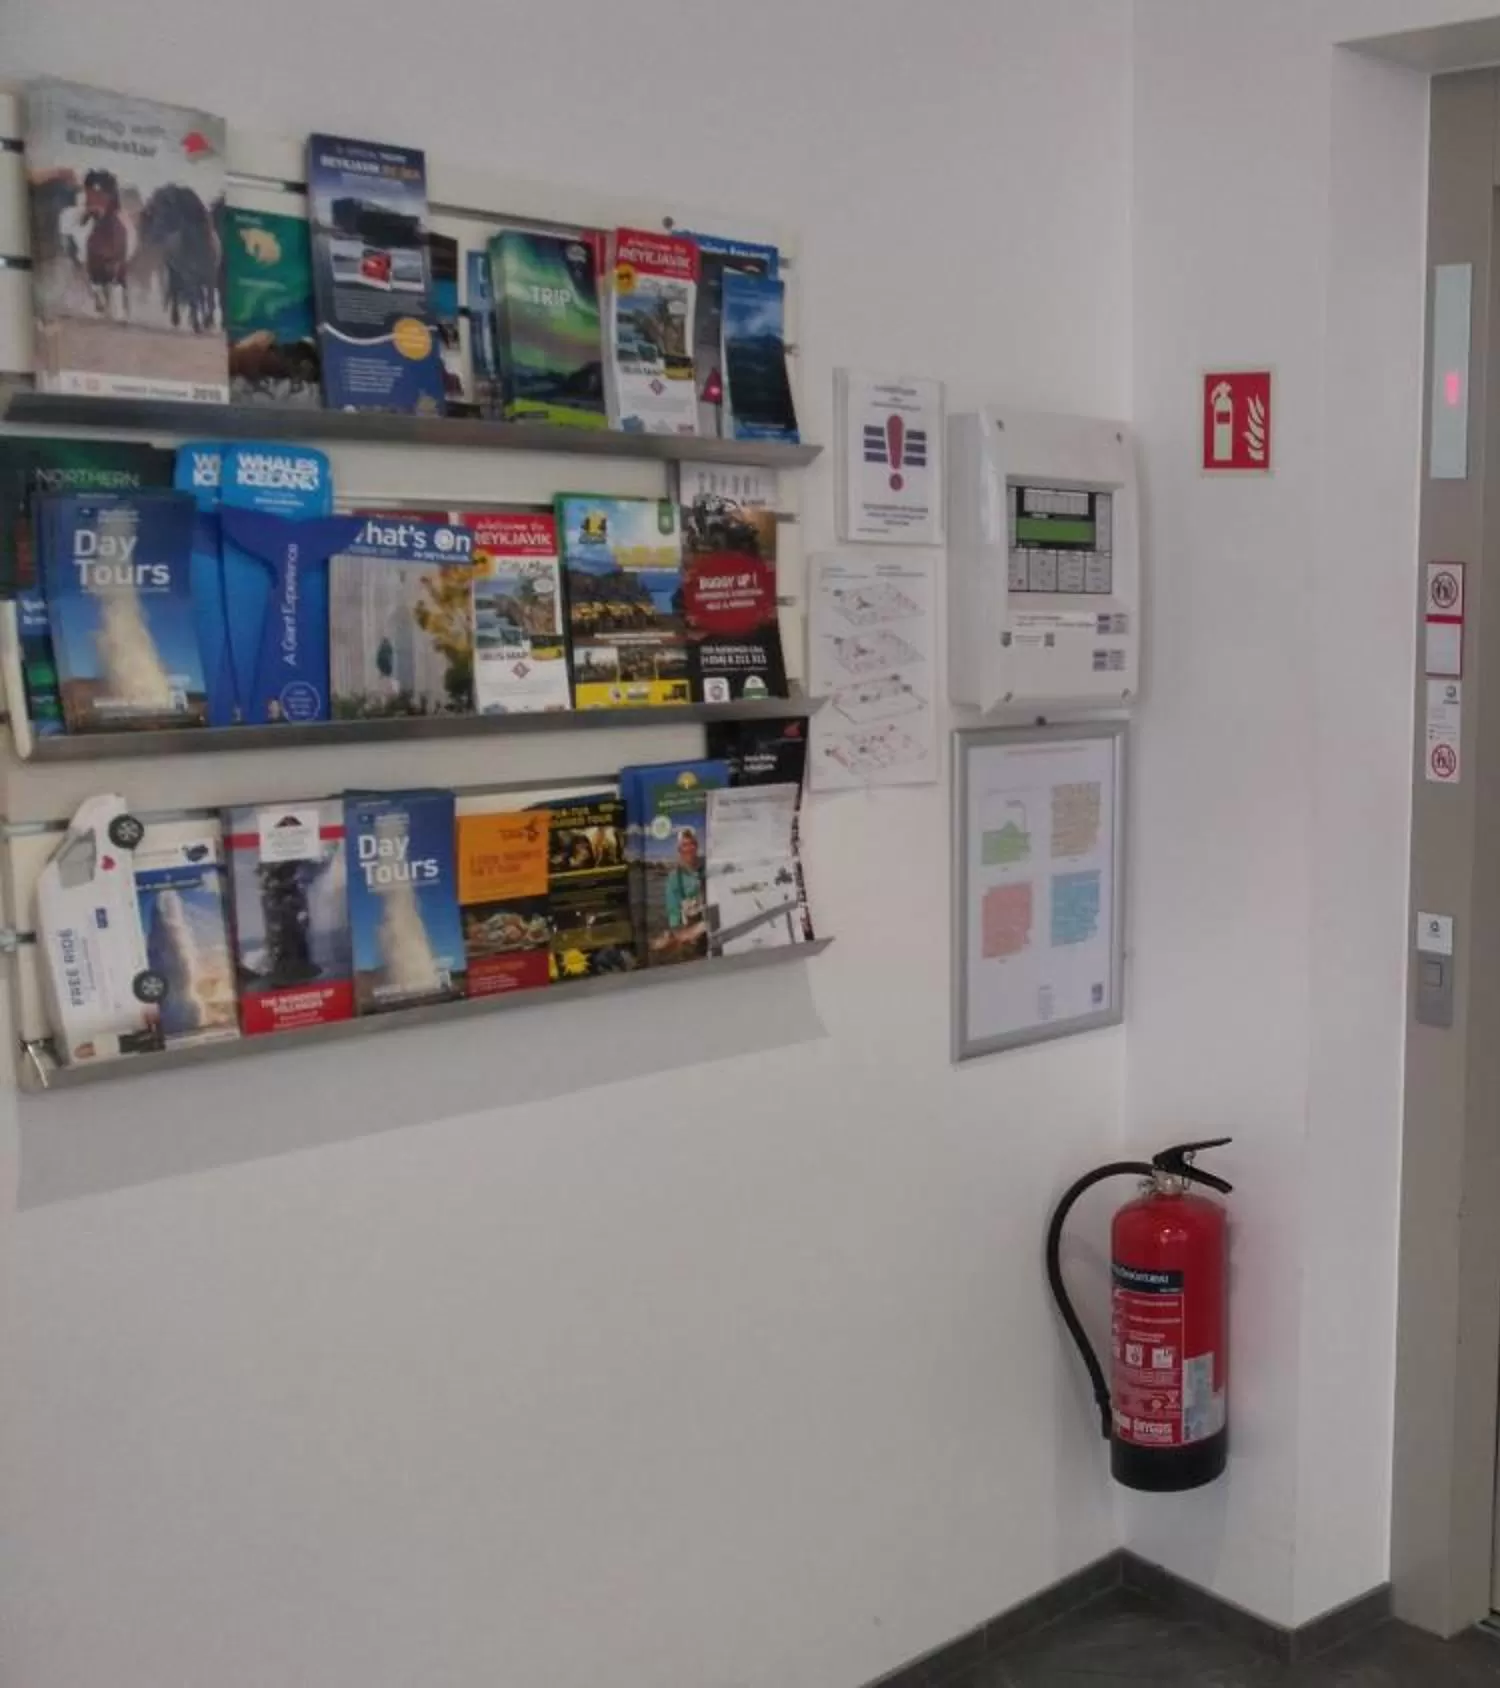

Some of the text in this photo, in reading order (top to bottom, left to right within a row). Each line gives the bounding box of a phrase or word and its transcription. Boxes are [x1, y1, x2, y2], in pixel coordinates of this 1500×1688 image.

[528, 285, 573, 307] TRIP
[34, 467, 142, 489] NORTHERN
[73, 529, 138, 561] Day
[354, 520, 472, 553] hat's On
[72, 558, 171, 586] Tours
[282, 652, 297, 667] A
[357, 834, 410, 862] Day
[359, 858, 439, 888] Tours
[65, 968, 85, 1007] FREE
